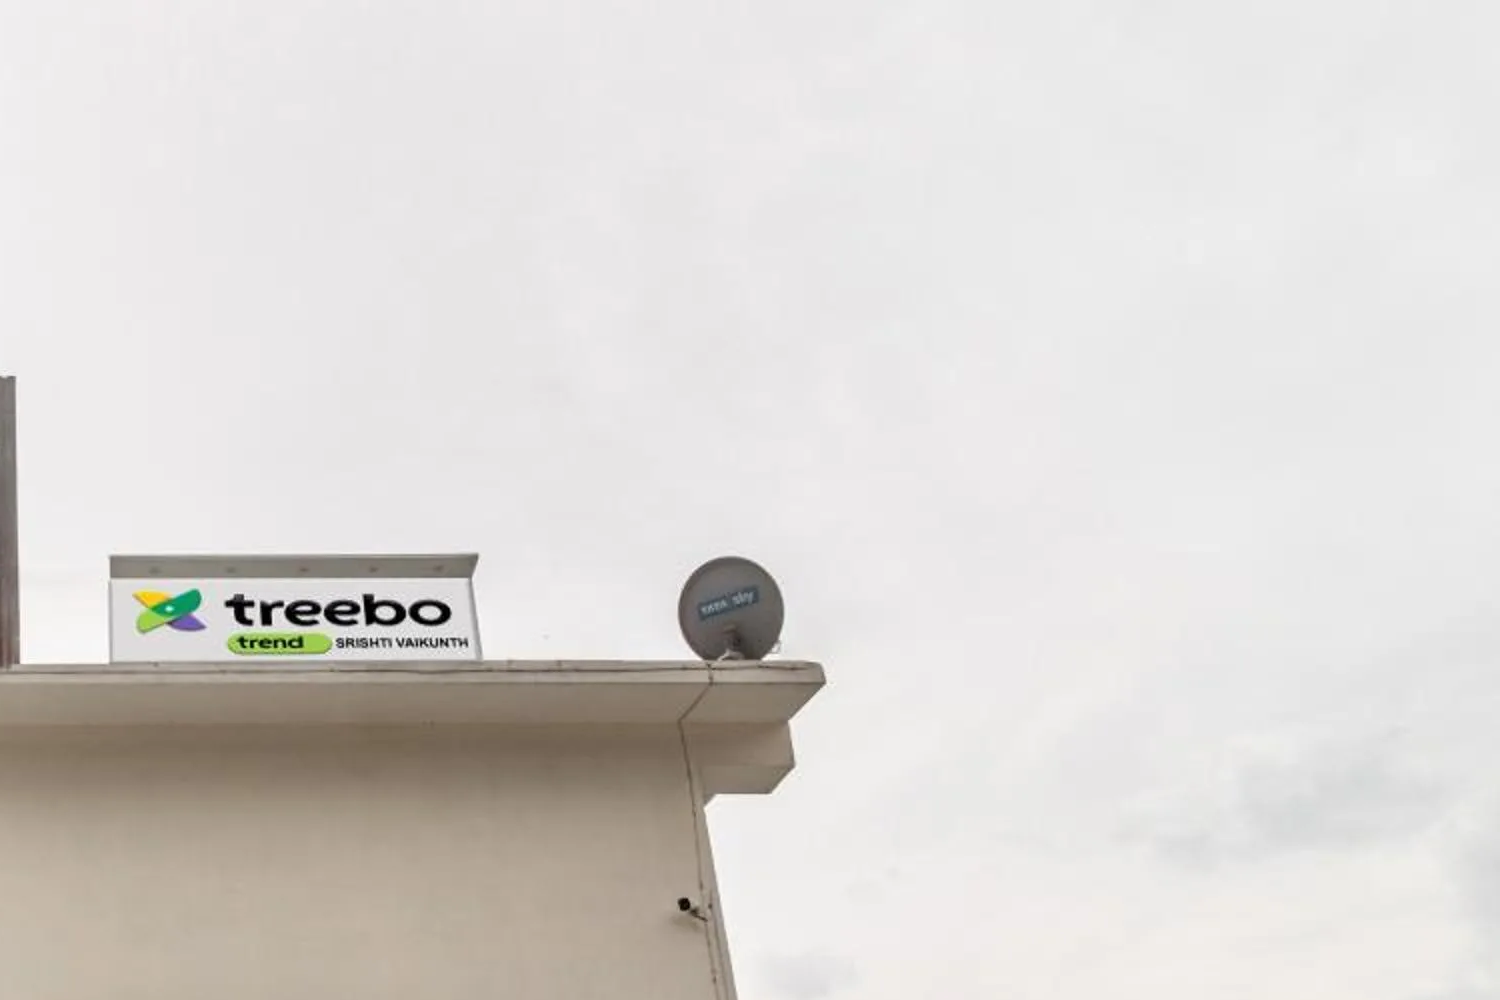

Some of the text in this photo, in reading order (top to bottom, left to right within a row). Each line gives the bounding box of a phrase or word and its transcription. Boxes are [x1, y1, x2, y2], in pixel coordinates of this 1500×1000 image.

[224, 593, 452, 628] treebo
[237, 634, 469, 650] trend SRISHTI VAIKUNTH
